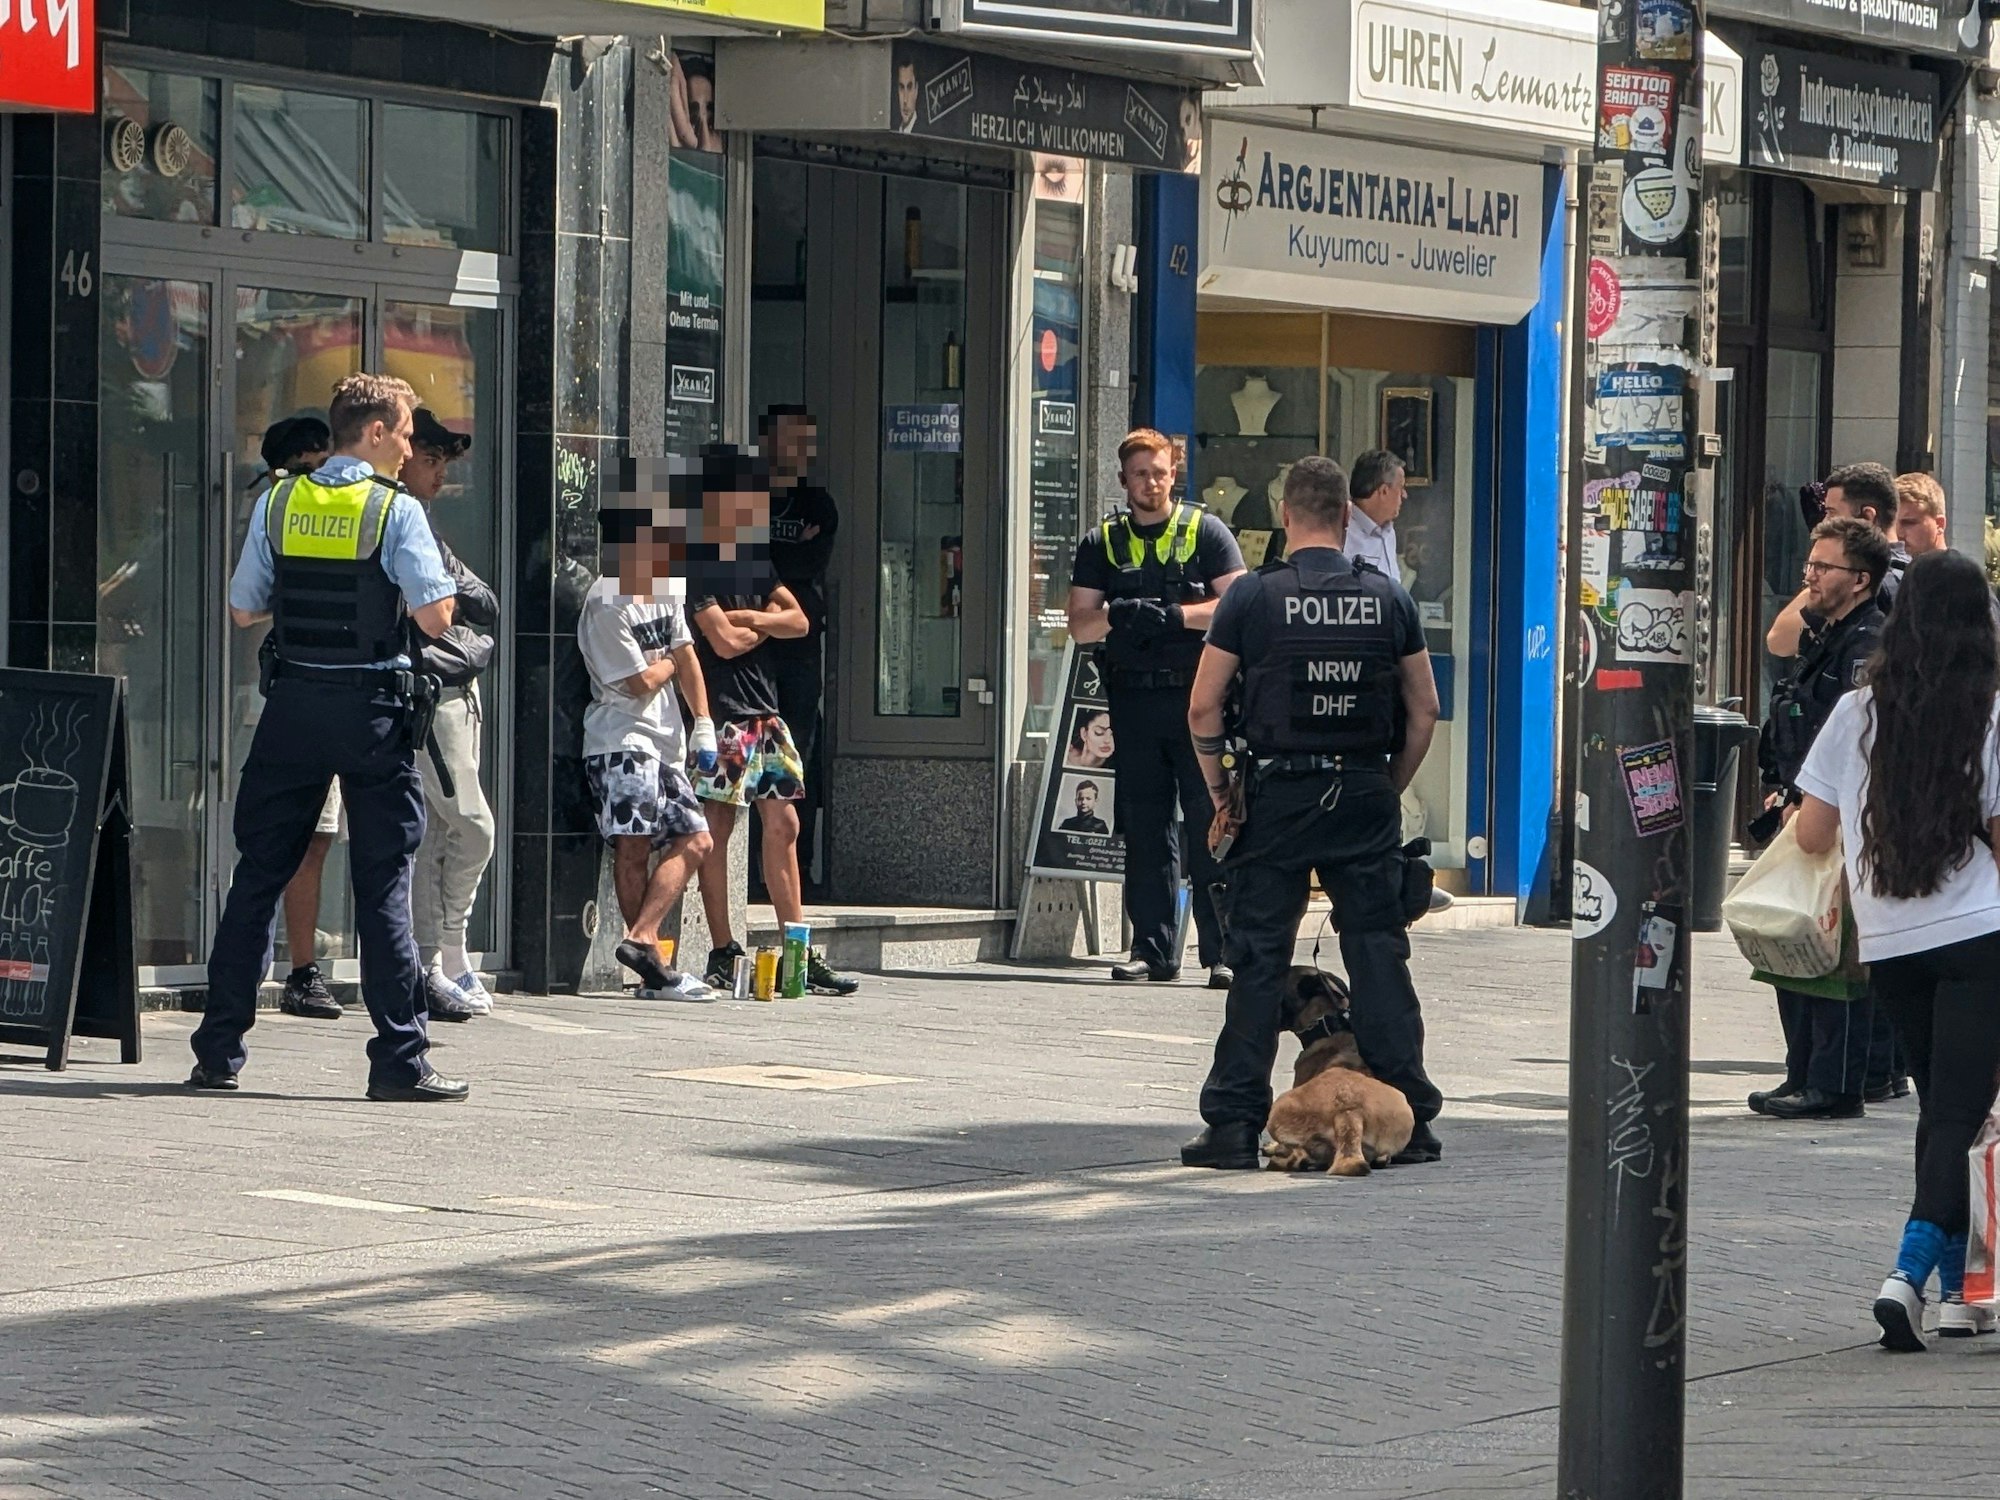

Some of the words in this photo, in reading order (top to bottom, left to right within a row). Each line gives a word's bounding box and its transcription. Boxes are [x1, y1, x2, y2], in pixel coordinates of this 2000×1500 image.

[1861, 0, 1938, 30] BRAUTMODEN
[1369, 21, 1463, 94] UHREN
[1471, 36, 1592, 126] Lennartz
[1799, 64, 1933, 144] Änderungsschneiderei
[971, 112, 1035, 146] HERZLICH
[1040, 126, 1124, 158] WILLKOMMEN
[1829, 133, 1840, 166] &
[1843, 135, 1899, 177] Boutique
[1169, 244, 1189, 276] 42
[1289, 224, 1389, 268] Kuyumcu
[1411, 238, 1497, 278] Juwelier
[60, 249, 92, 297] 46
[679, 290, 692, 307] Mit
[693, 292, 709, 309] und
[669, 311, 691, 328] Ohne
[692, 313, 719, 331] Termin
[1612, 375, 1663, 389] HELLO
[888, 427, 962, 444] freihalten
[896, 410, 960, 433] Eingang
[288, 513, 355, 539] POLIZEI
[1284, 596, 1382, 625] POLIZEI
[1307, 661, 1362, 682] NRW
[1312, 695, 1357, 716] DHF
[0, 845, 51, 881] affe
